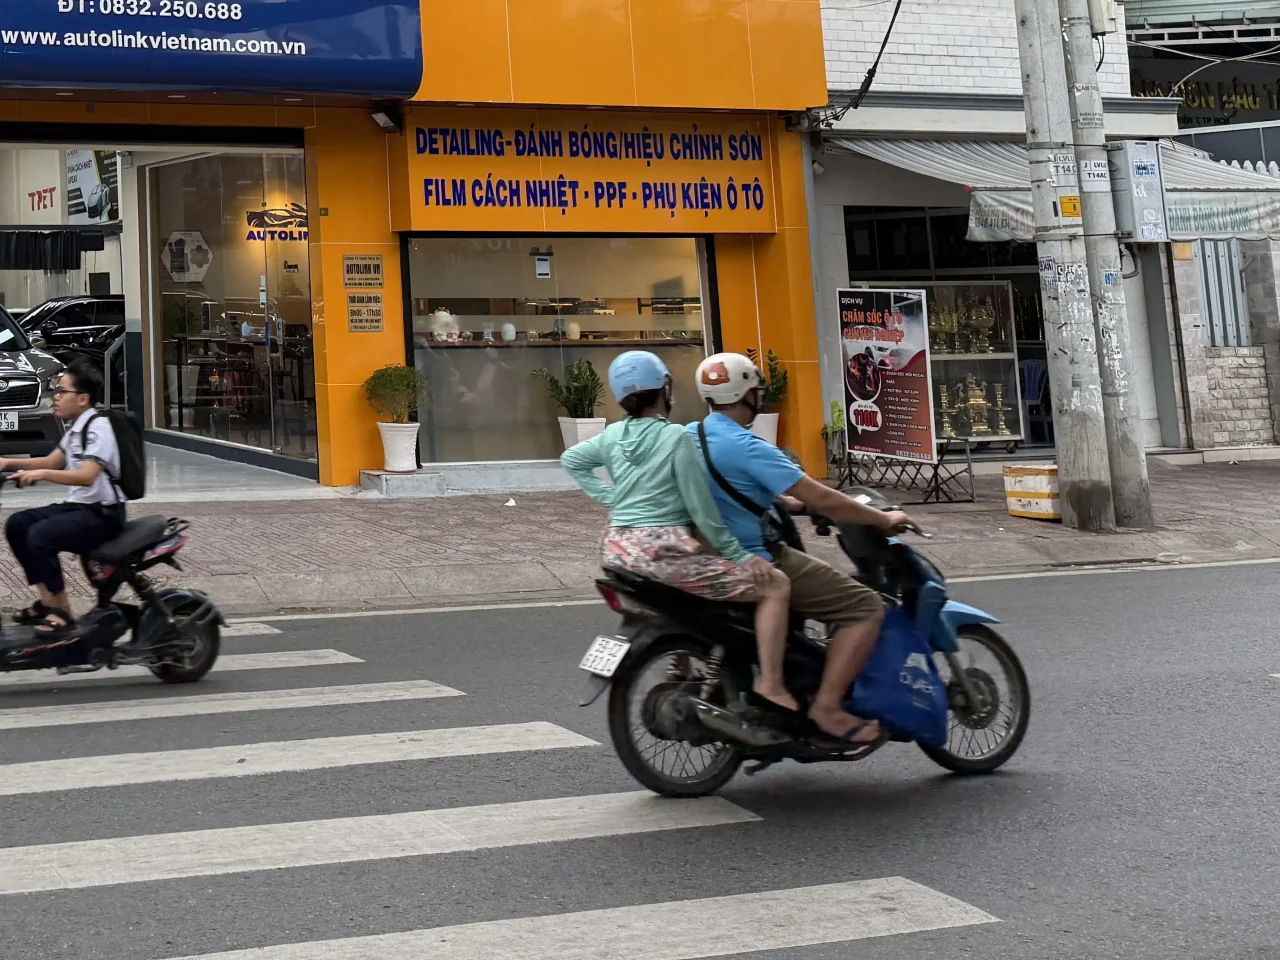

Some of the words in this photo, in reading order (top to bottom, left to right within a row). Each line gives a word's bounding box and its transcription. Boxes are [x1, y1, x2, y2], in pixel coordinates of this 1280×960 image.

[0, 26, 307, 57] www.autolinkvietnam.com.vn
[669, 123, 724, 161] CHỈNH
[728, 129, 763, 161] SƠN
[28, 186, 56, 211] TPET
[423, 177, 466, 207] FILM
[471, 173, 520, 208] CÁCH
[525, 173, 579, 216] NHIỆT
[594, 180, 627, 209] PPF
[642, 181, 676, 218] PHỤ
[681, 176, 722, 218] KIỆN
[726, 175, 739, 211] Ô
[741, 176, 765, 211] TÔ
[841, 297, 855, 305] DỊCH
[855, 298, 863, 306] VỤ
[842, 308, 865, 323] CHĂM
[866, 308, 882, 324] SÓC
[854, 409, 879, 429] 110K
